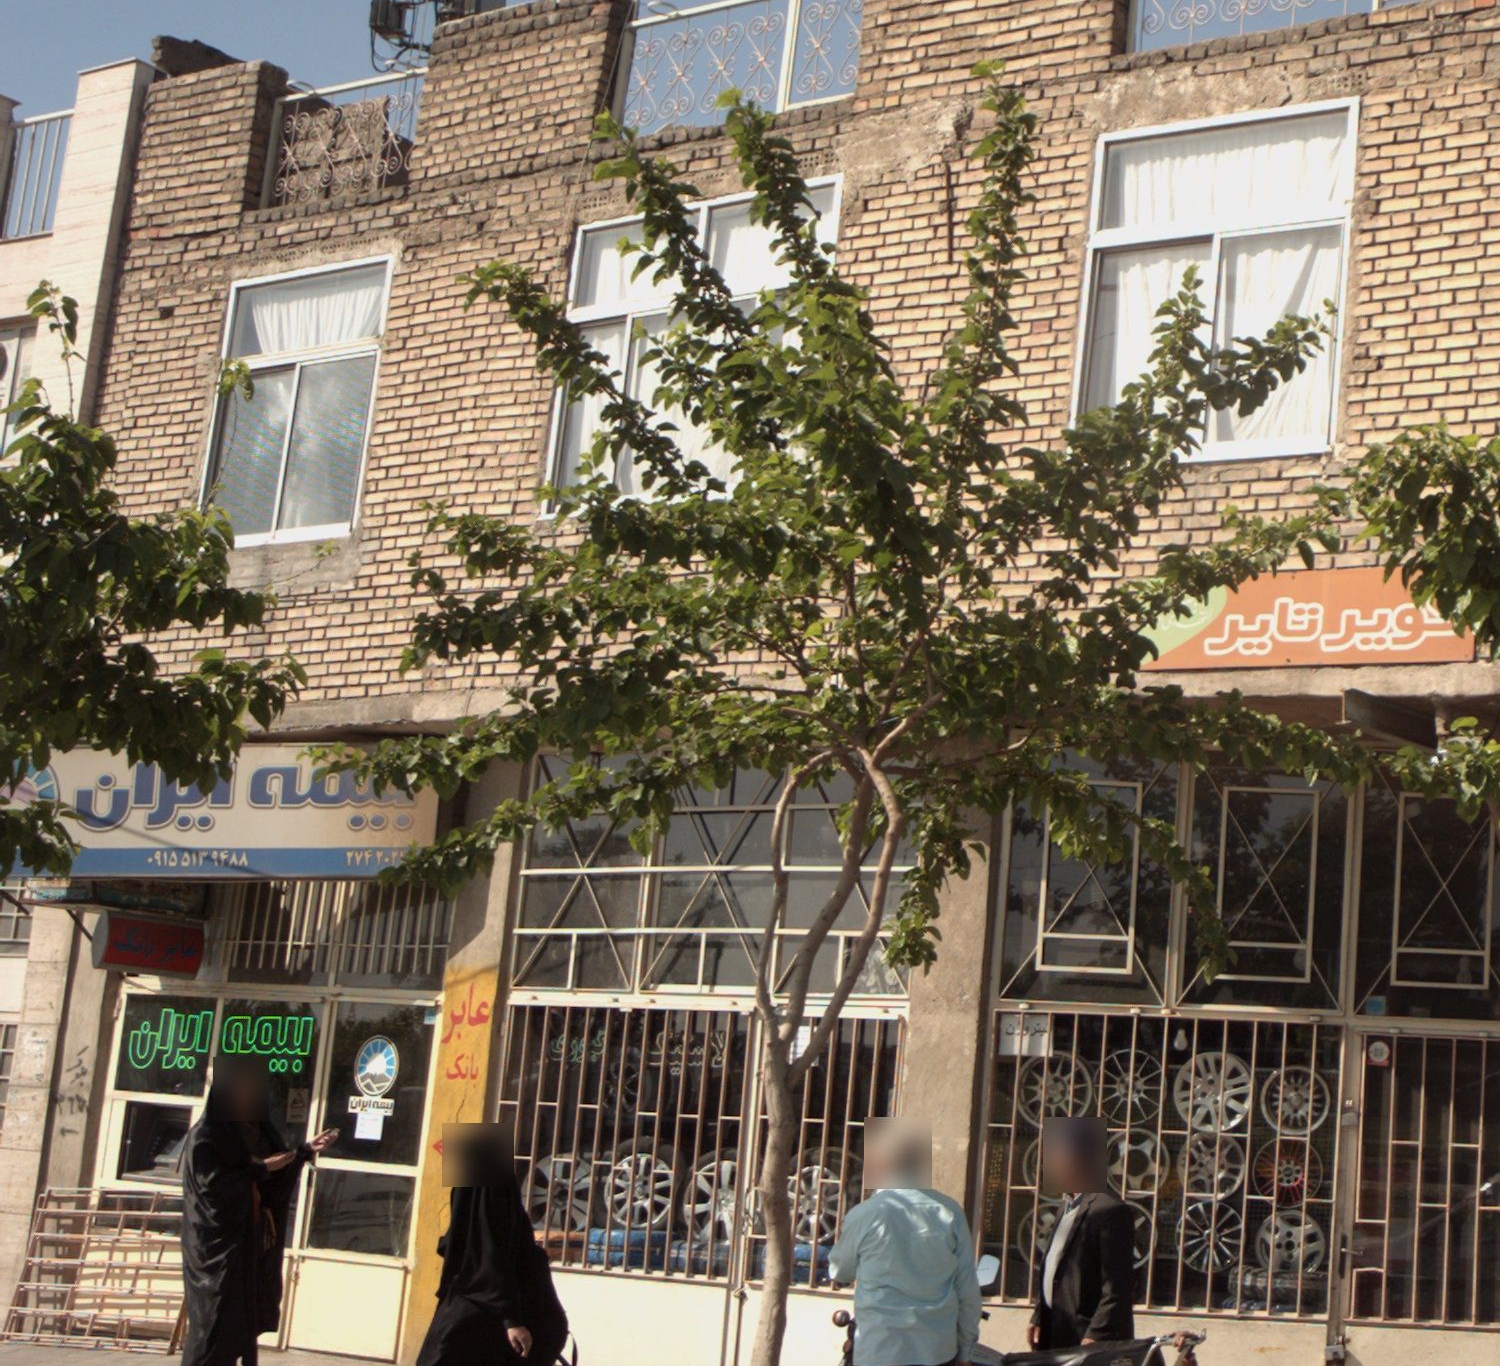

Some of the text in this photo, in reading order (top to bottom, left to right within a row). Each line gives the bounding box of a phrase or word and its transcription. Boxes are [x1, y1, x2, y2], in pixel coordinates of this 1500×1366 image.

[1204, 597, 1325, 655] تایر
[128, 1008, 214, 1069] ایران
[441, 983, 490, 1044] عابر
[221, 1015, 314, 1073] بیمه
[446, 1053, 479, 1088] بانک
